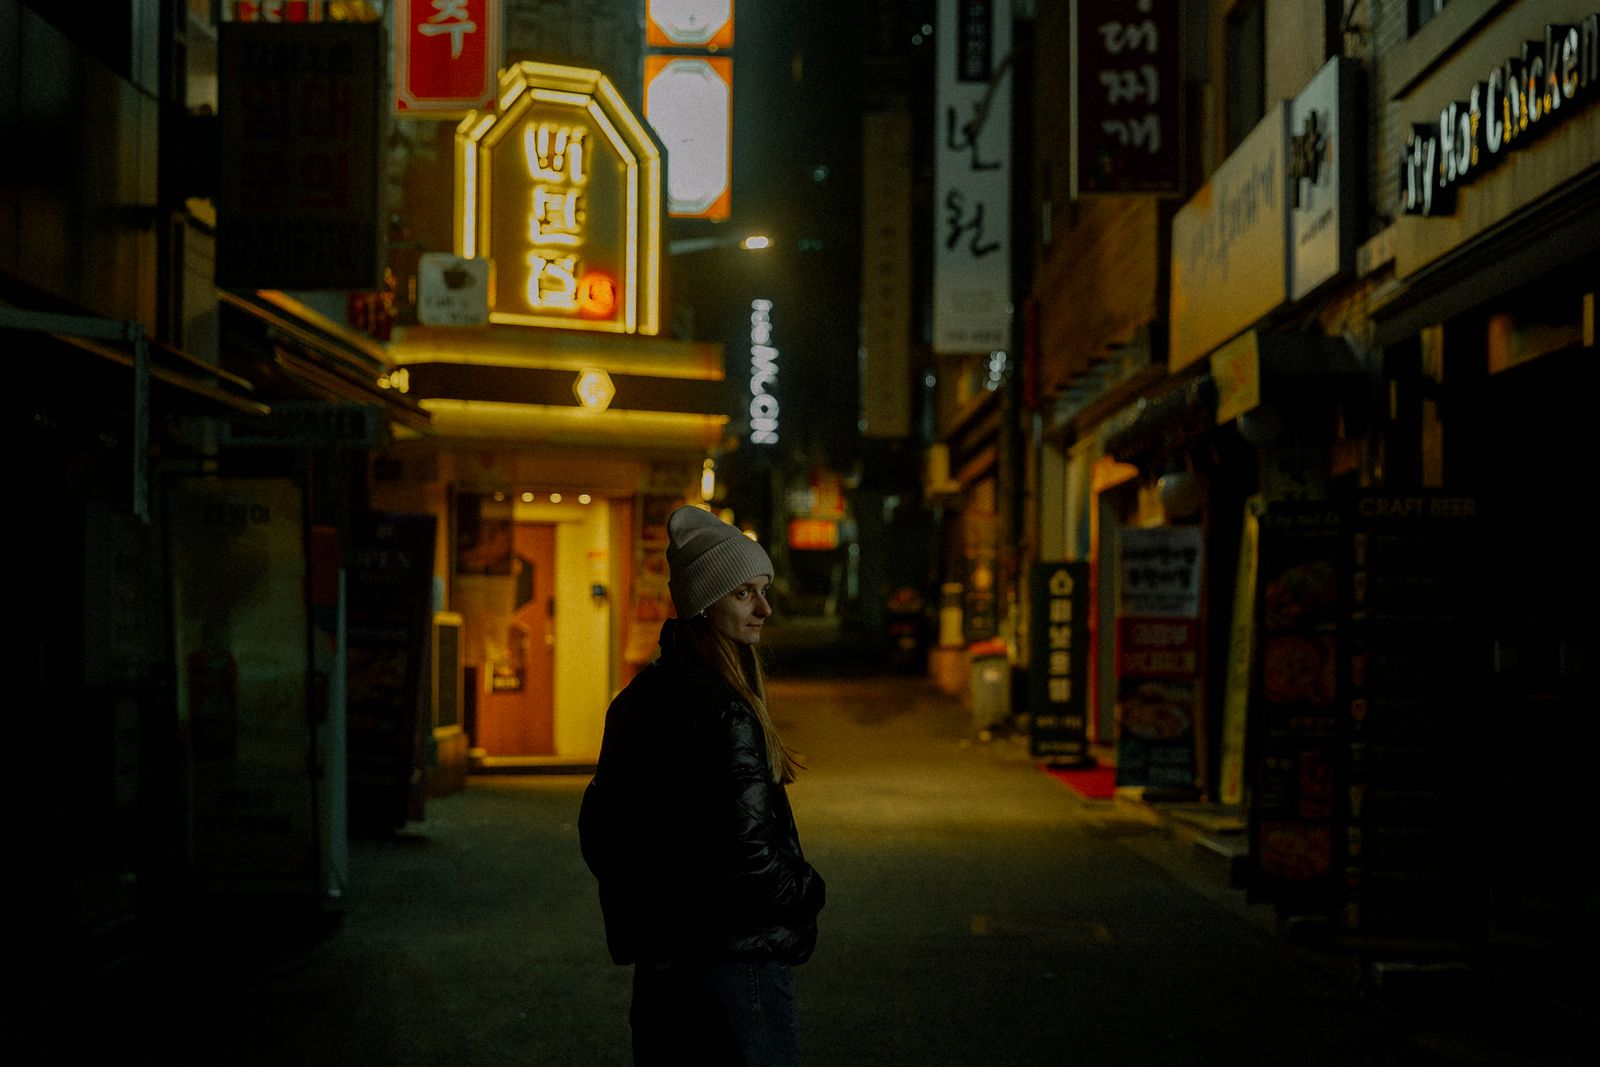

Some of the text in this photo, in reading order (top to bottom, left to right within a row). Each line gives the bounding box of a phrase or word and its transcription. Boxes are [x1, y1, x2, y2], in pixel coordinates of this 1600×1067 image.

[1098, 0, 1161, 153] 대찌개
[1440, 102, 1479, 187] Hot
[1486, 13, 1598, 154] Chicken
[240, 79, 353, 142] 임대
[240, 150, 349, 209] 문의
[1359, 496, 1477, 517] CRAFT BEER
